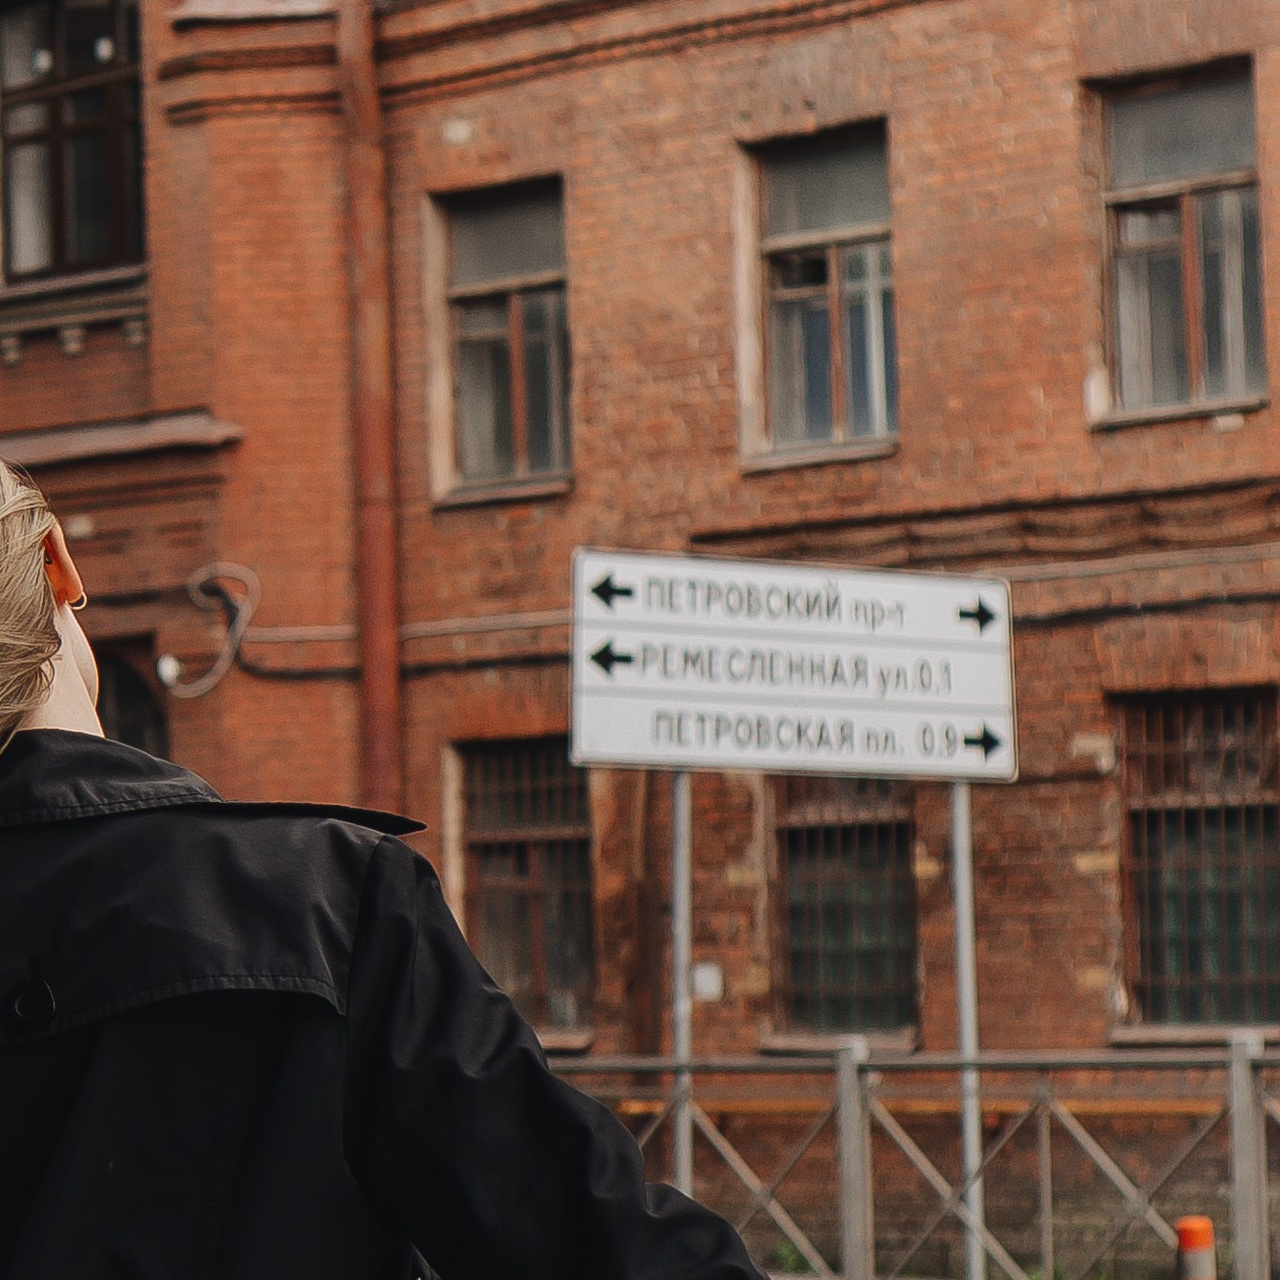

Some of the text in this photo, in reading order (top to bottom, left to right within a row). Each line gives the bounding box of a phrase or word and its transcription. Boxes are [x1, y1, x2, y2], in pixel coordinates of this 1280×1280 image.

[646, 576, 907, 631] ПЕТРОВСКИЙ пр-т
[641, 643, 869, 690] РЕМЕСЛЕННАЯ
[655, 710, 854, 752] ПЕТРОВСКАЯ
[866, 728, 904, 756] пл.
